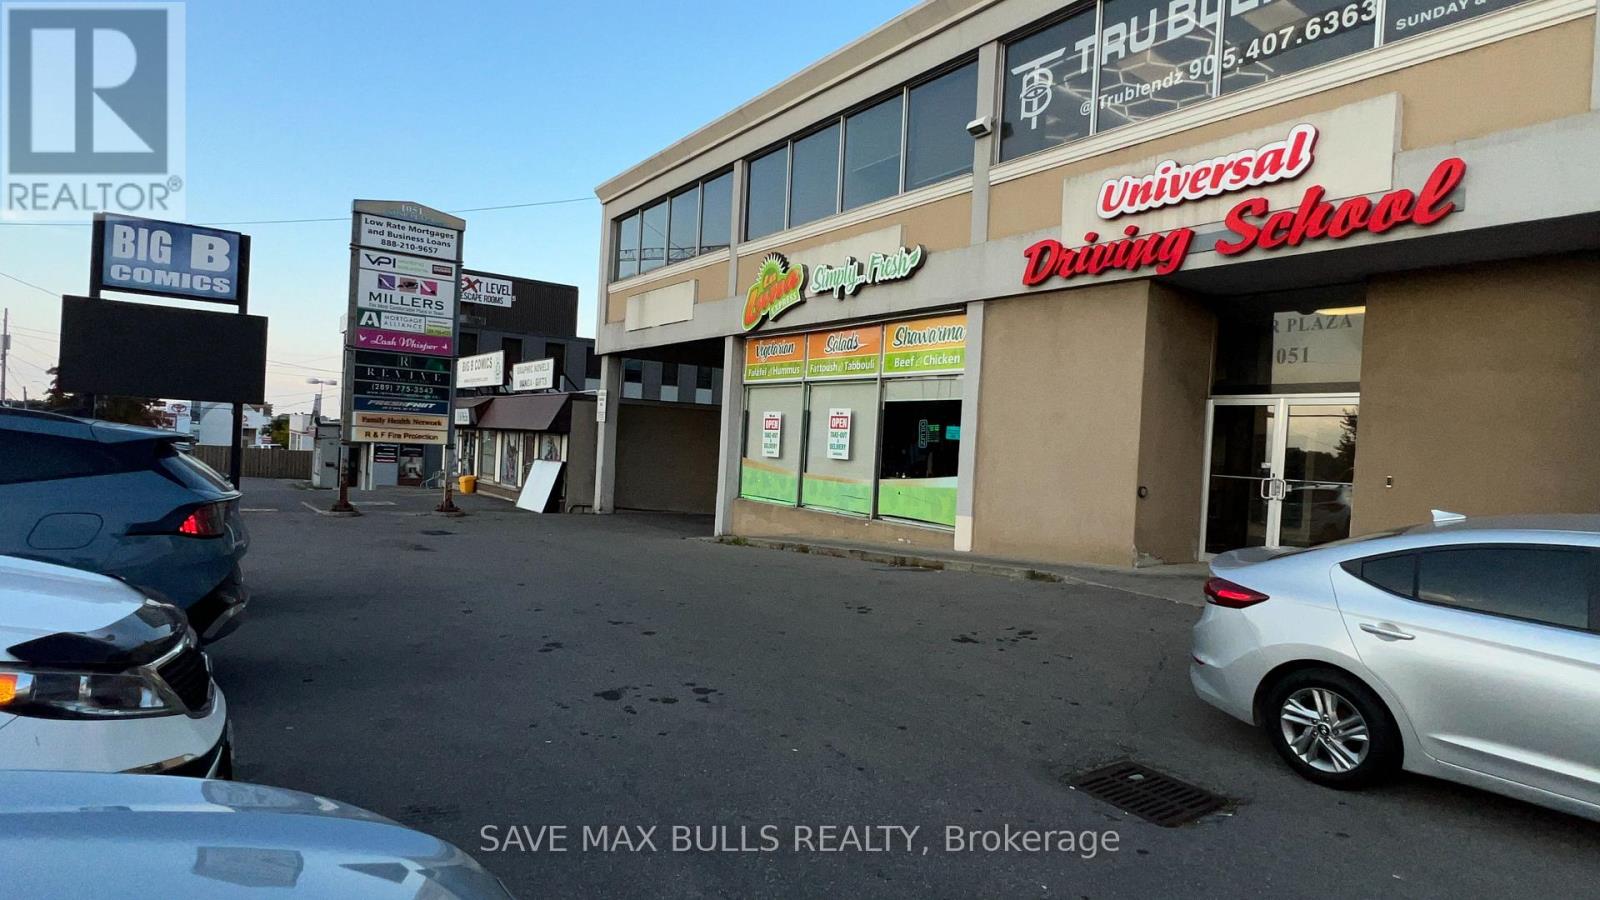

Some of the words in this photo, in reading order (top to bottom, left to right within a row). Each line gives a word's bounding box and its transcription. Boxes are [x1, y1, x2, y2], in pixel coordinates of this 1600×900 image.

[1395, 0, 1468, 31] SUNDAY
[1099, 126, 1316, 217] Universal
[364, 217, 384, 227] Low
[386, 221, 406, 231] Rate
[408, 225, 455, 240] Mortgages
[1022, 225, 1195, 286] Driving
[1215, 157, 1467, 256] School
[367, 228, 385, 236] and
[387, 231, 425, 243] Business
[426, 238, 451, 248] Loans
[380, 239, 439, 254] 888-210-9657
[112, 224, 173, 265] BIG
[190, 233, 231, 273] B
[866, 247, 910, 283] Fresh
[110, 264, 231, 294] COMICS
[486, 282, 512, 296] LEVEL
[368, 291, 445, 311] MILLERS
[484, 295, 504, 304] ROOMS
[383, 321, 423, 330] ALLIANCE
[384, 315, 423, 324] MORTGAGE
[1287, 314, 1352, 333] PLAZA
[370, 335, 397, 346] Lash
[825, 331, 859, 353] Salads
[892, 325, 965, 347] Shawarma
[756, 340, 796, 360] Vegetarian
[462, 360, 470, 372] BIG
[475, 357, 493, 371] COMICS
[809, 362, 838, 373] Fattoush
[844, 359, 875, 370] Tabbouli
[894, 355, 916, 368] Beef
[923, 352, 961, 366] Chicken
[748, 367, 767, 377] Falafel
[773, 365, 800, 376] Hummus
[361, 416, 386, 425] Family
[387, 417, 411, 425] Health
[765, 419, 778, 429] OPEN
[831, 417, 847, 429] OPEN
